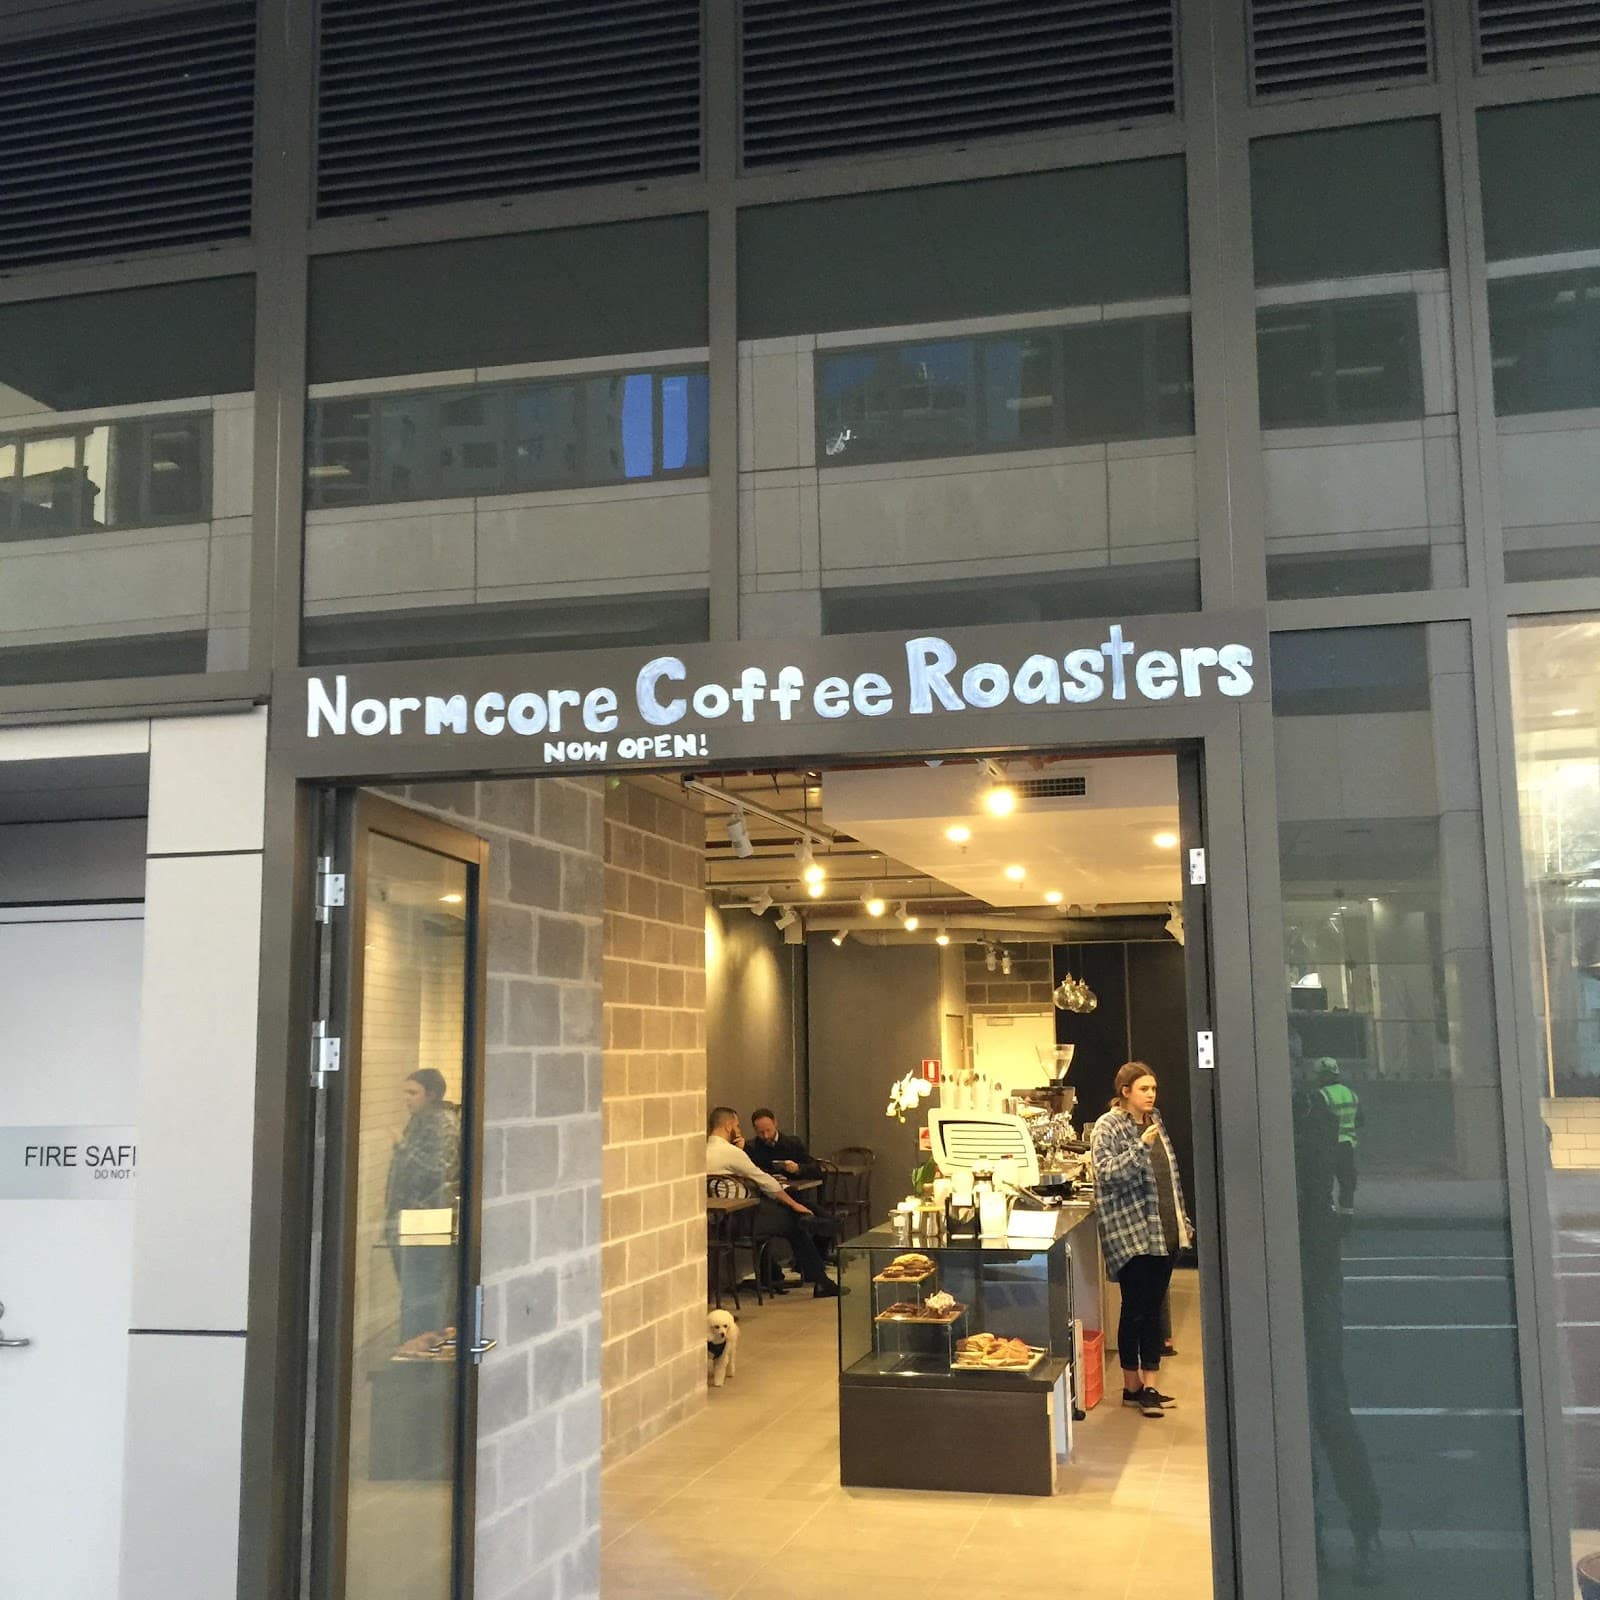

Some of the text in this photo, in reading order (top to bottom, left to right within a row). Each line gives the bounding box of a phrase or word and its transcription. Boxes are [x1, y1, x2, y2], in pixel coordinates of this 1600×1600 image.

[636, 656, 893, 726] Coffee
[905, 624, 1255, 714] Roasters
[544, 734, 709, 763] NOW OPEN!
[25, 1145, 136, 1167] FIRE SAF
[94, 1169, 109, 1180] DO
[110, 1169, 131, 1180] NOT
